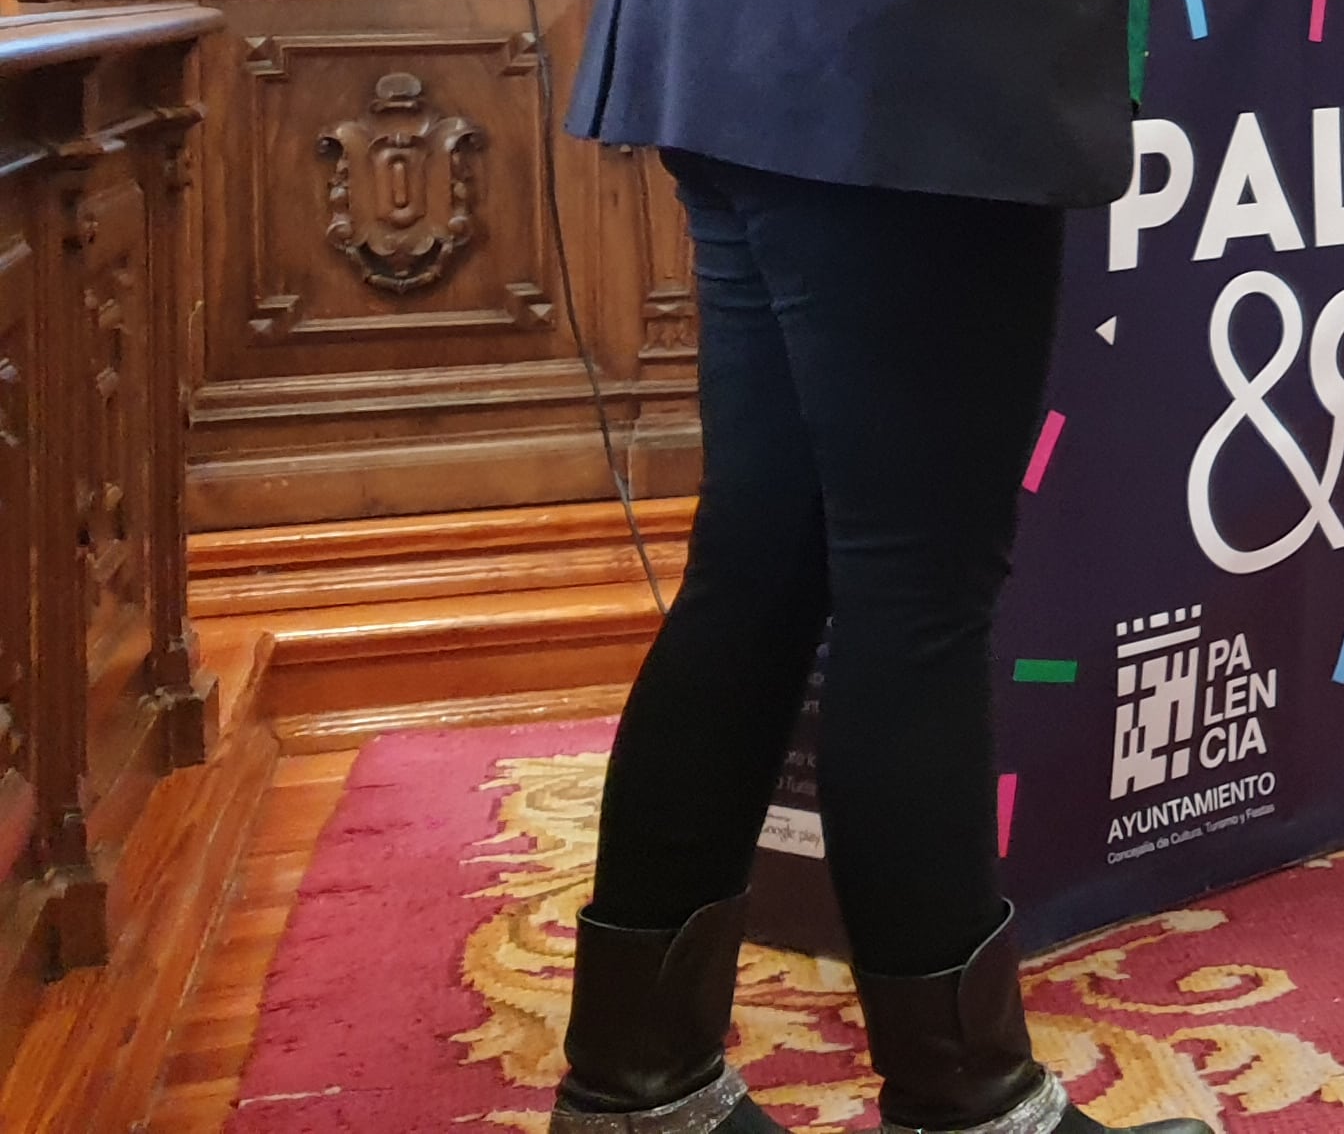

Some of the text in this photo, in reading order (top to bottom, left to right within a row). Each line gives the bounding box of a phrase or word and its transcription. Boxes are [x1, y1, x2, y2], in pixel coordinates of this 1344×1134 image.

[1206, 632, 1251, 682] PA
[1203, 668, 1277, 727] LEN
[1200, 717, 1268, 769] CIA
[1107, 771, 1276, 845] AYUNTAMIENTO
